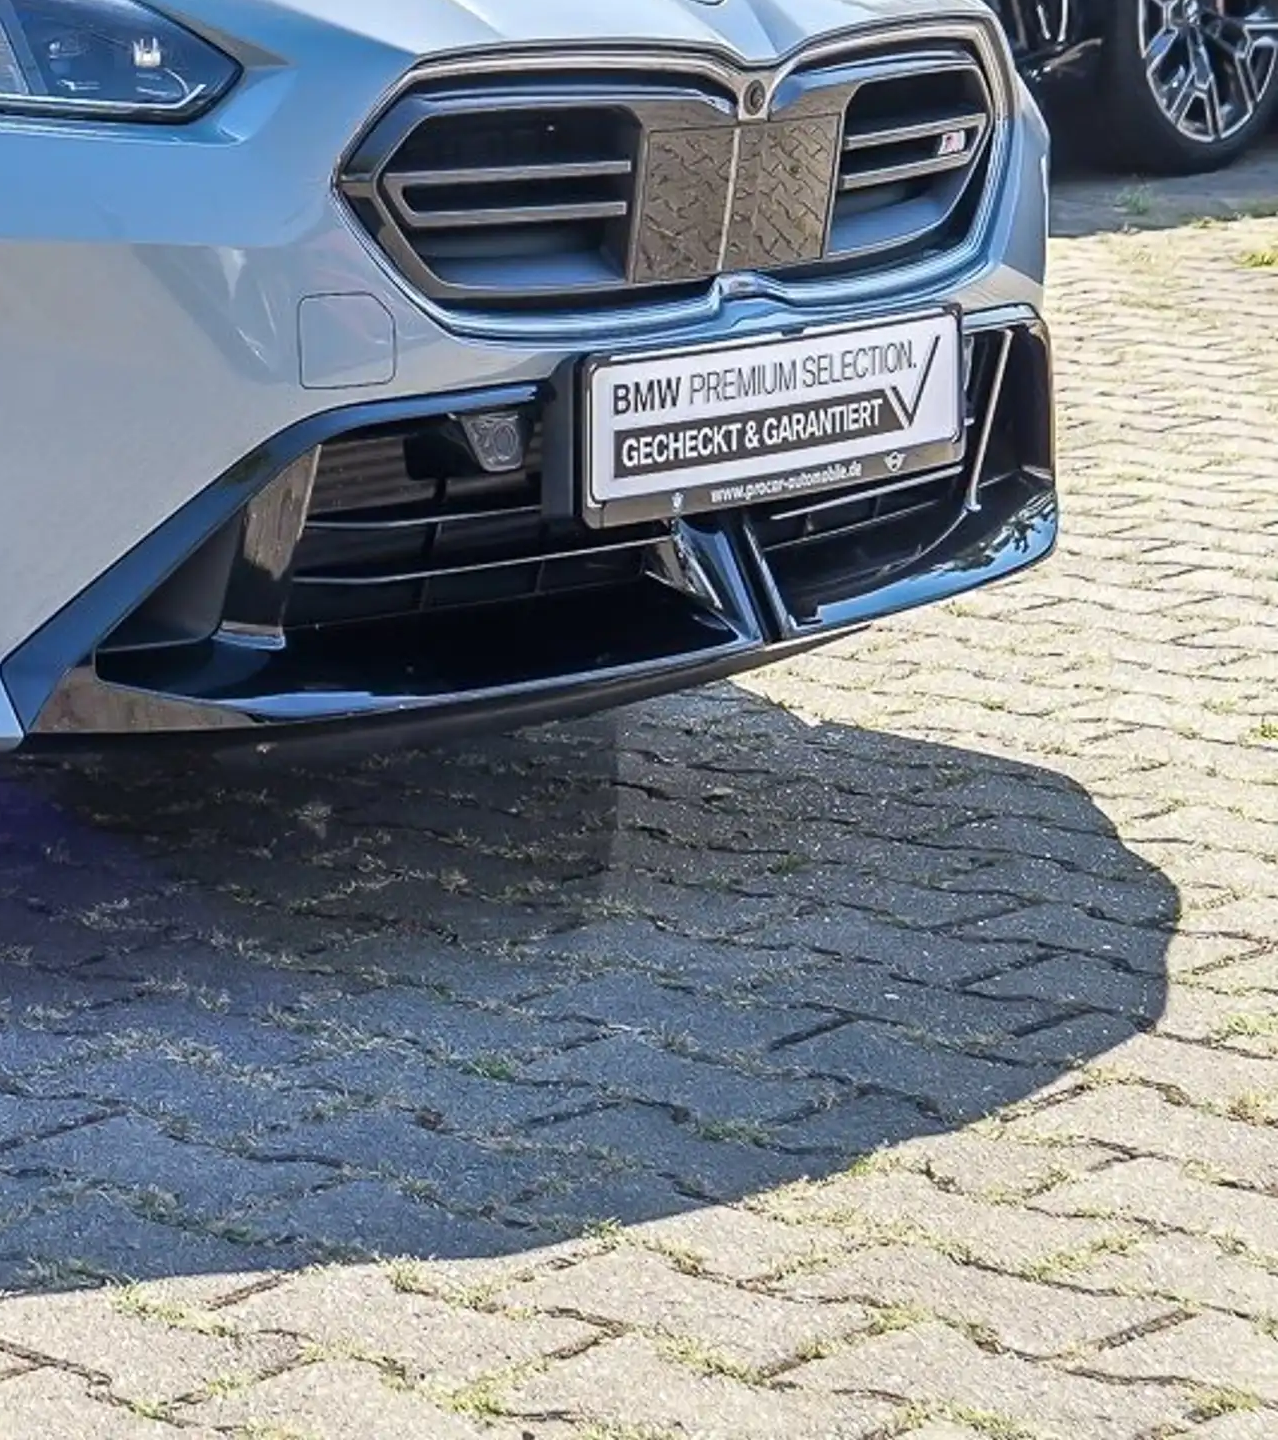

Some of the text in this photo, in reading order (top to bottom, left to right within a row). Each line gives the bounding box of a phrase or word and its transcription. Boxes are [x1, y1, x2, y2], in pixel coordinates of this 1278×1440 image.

[613, 339, 918, 417] BMW PREMIUM SELECTION.
[621, 397, 885, 469] GECHECKT & GARANTIERT
[710, 460, 863, 501] www.procar-automobile.de
